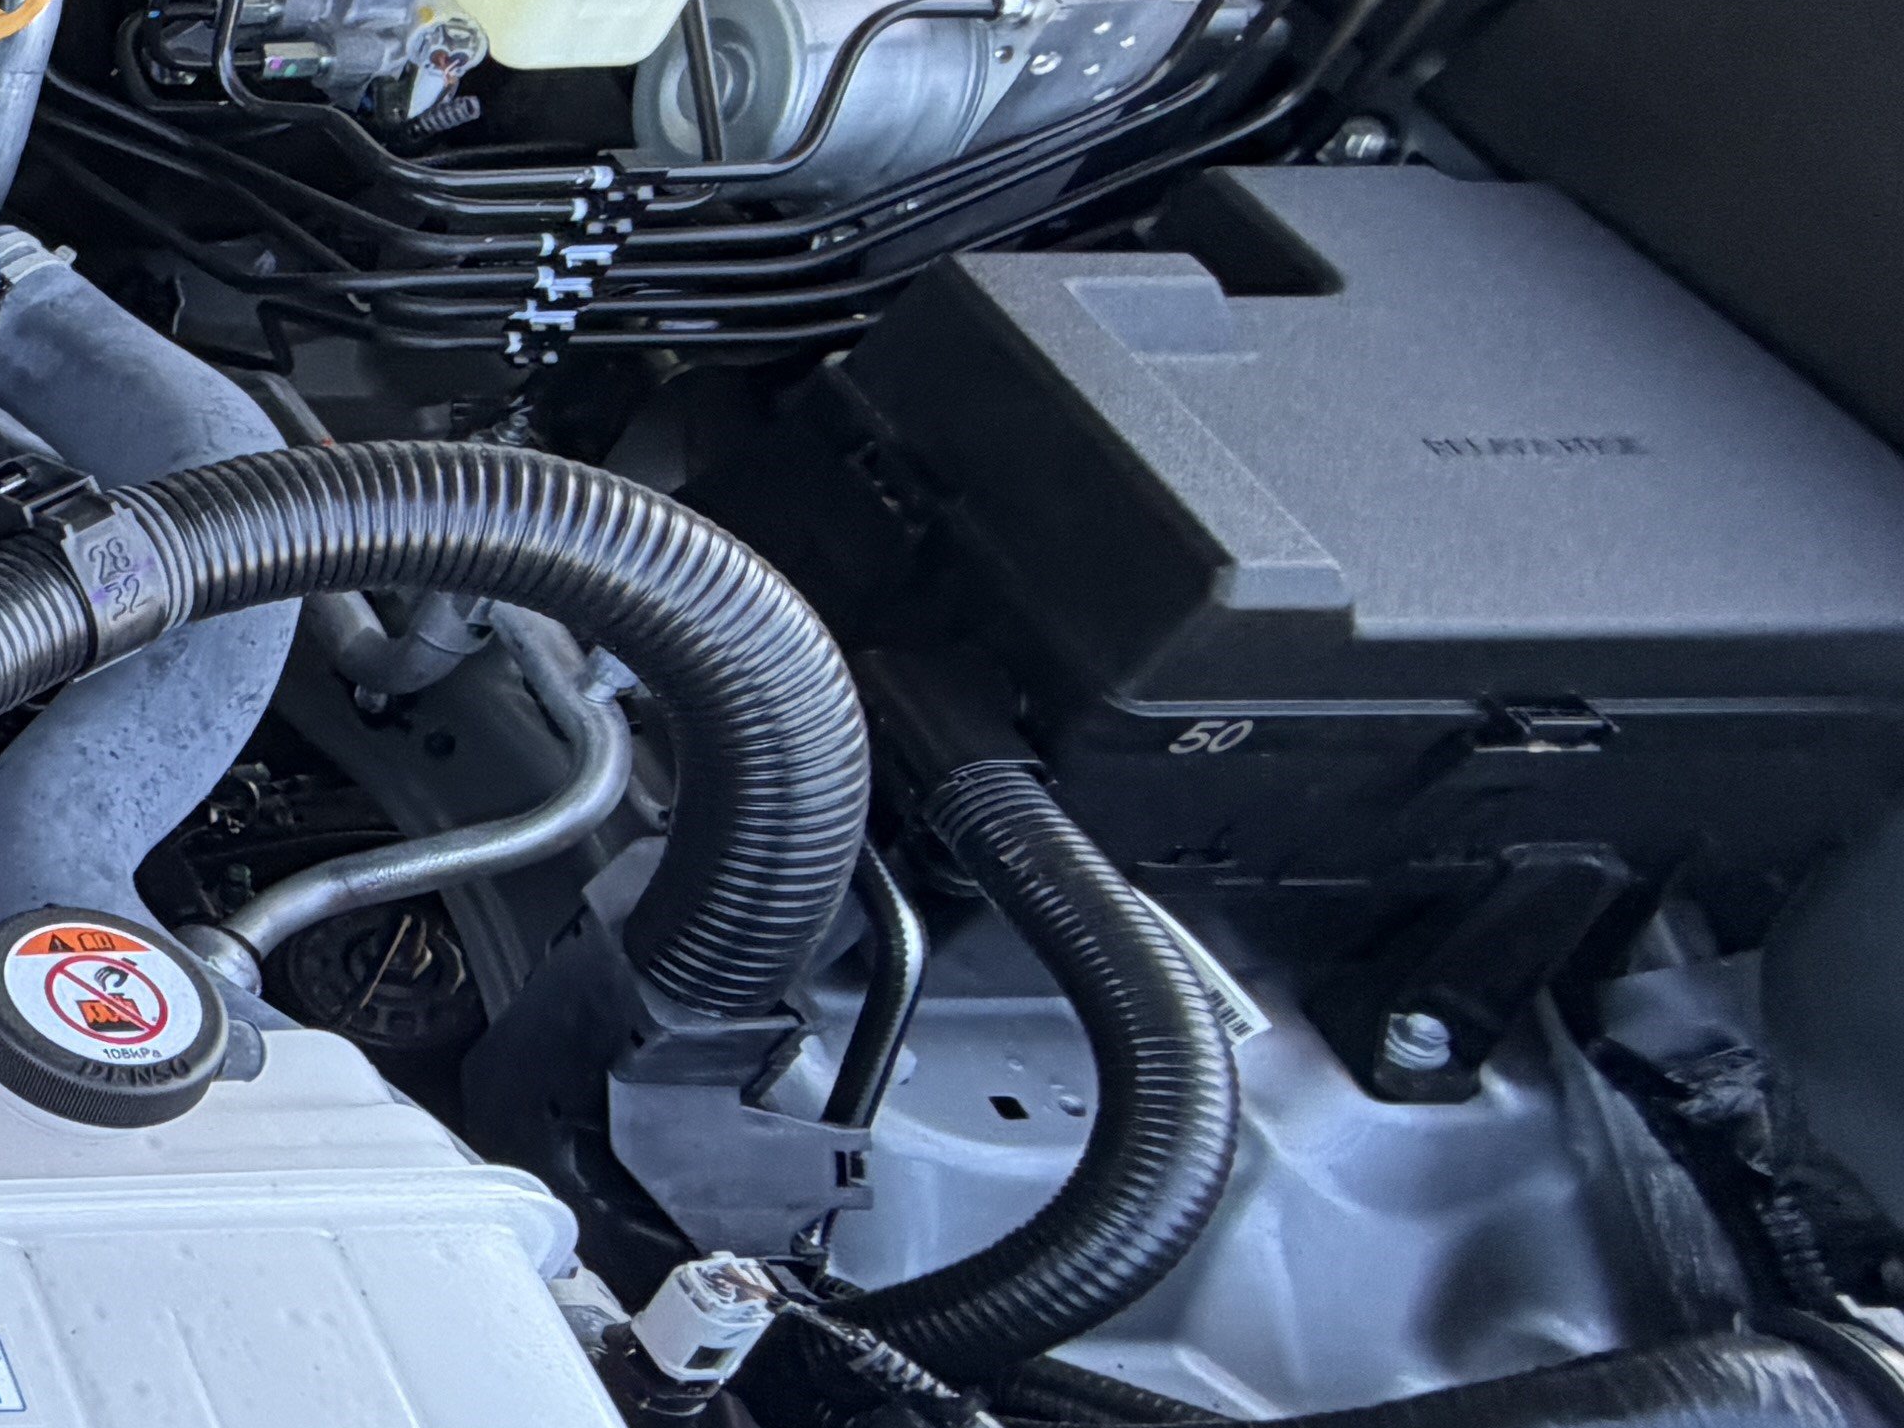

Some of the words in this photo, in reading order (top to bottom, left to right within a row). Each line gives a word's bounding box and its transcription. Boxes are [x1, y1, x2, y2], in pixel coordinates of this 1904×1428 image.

[88, 536, 131, 585] 28
[1168, 719, 1254, 754] 50
[79, 1058, 190, 1087] DENSO
